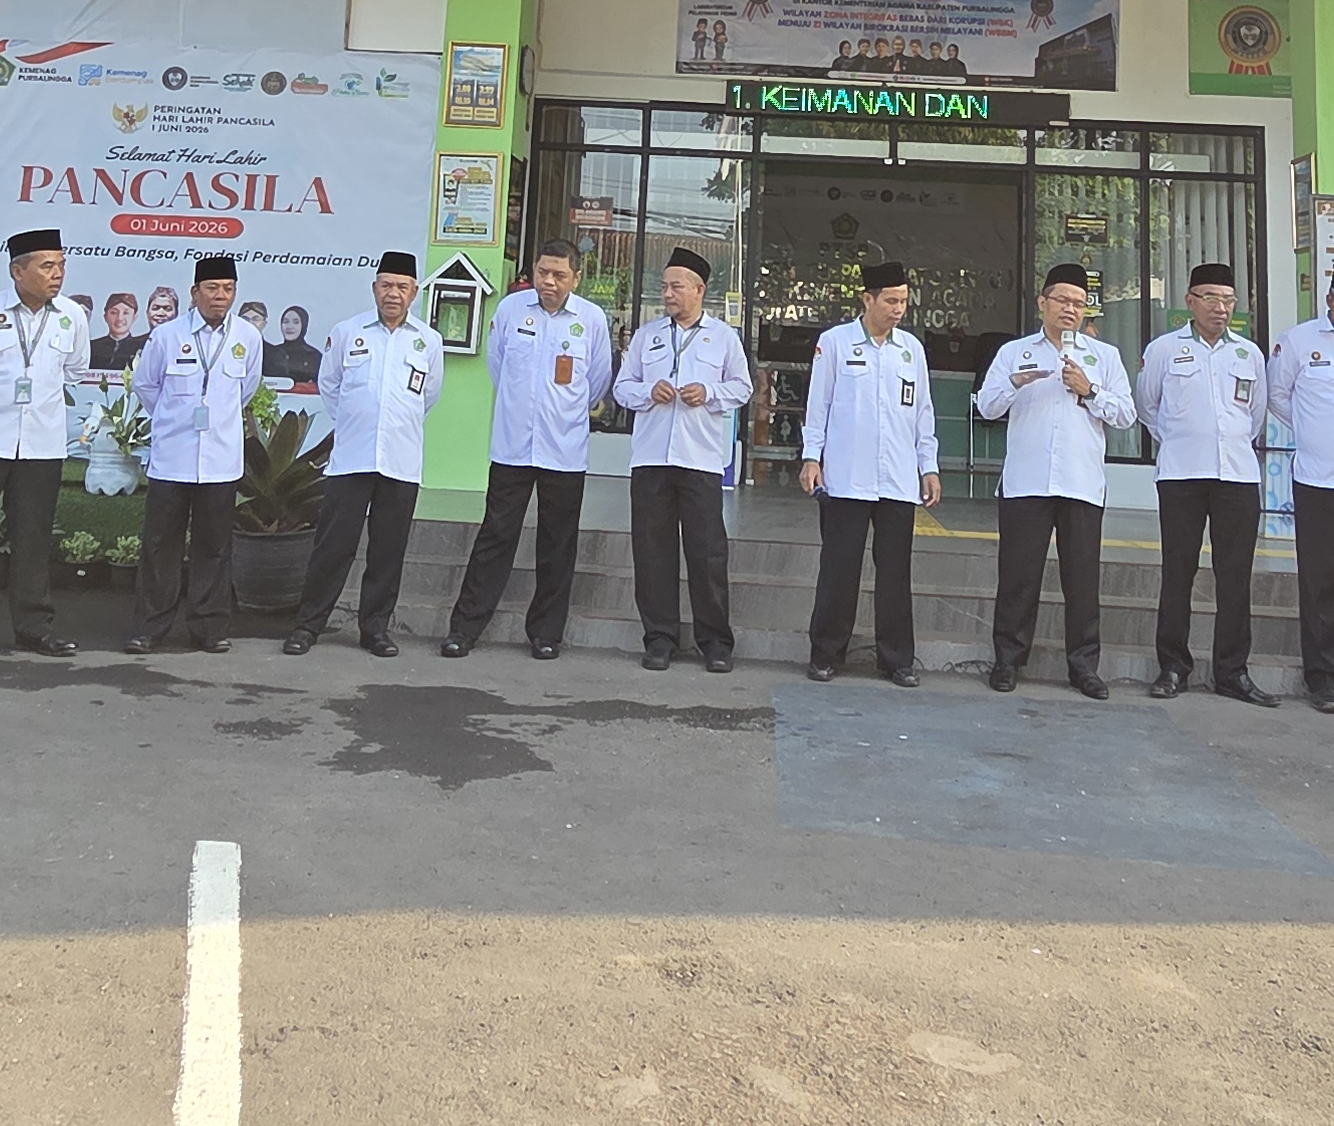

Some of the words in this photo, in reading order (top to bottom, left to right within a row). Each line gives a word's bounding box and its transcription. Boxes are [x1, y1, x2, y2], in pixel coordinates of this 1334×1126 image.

[783, 9, 822, 18] WILAYAH
[824, 11, 848, 19] ZONA
[823, 21, 862, 30] WILAYAH
[733, 85, 751, 110] 1.
[762, 85, 915, 117] KEIMANAN
[925, 93, 988, 119] DAN
[154, 105, 221, 115] PERINGATAN
[153, 115, 179, 123] HARI
[182, 116, 213, 124] LAHIR
[217, 117, 275, 127] PANCASILA
[157, 125, 182, 133] JUNI
[186, 126, 209, 134] 2026
[106, 146, 176, 162] Selamat
[176, 147, 215, 163] Hari
[216, 150, 267, 166] Lahir
[17, 165, 335, 214] PANCASILA
[130, 218, 146, 231] 01
[149, 218, 185, 232] Juni
[189, 221, 228, 234] 2026
[62, 245, 111, 257] ersatu
[115, 246, 178, 261] Bangsa,
[252, 251, 352, 267] Perdamaian
